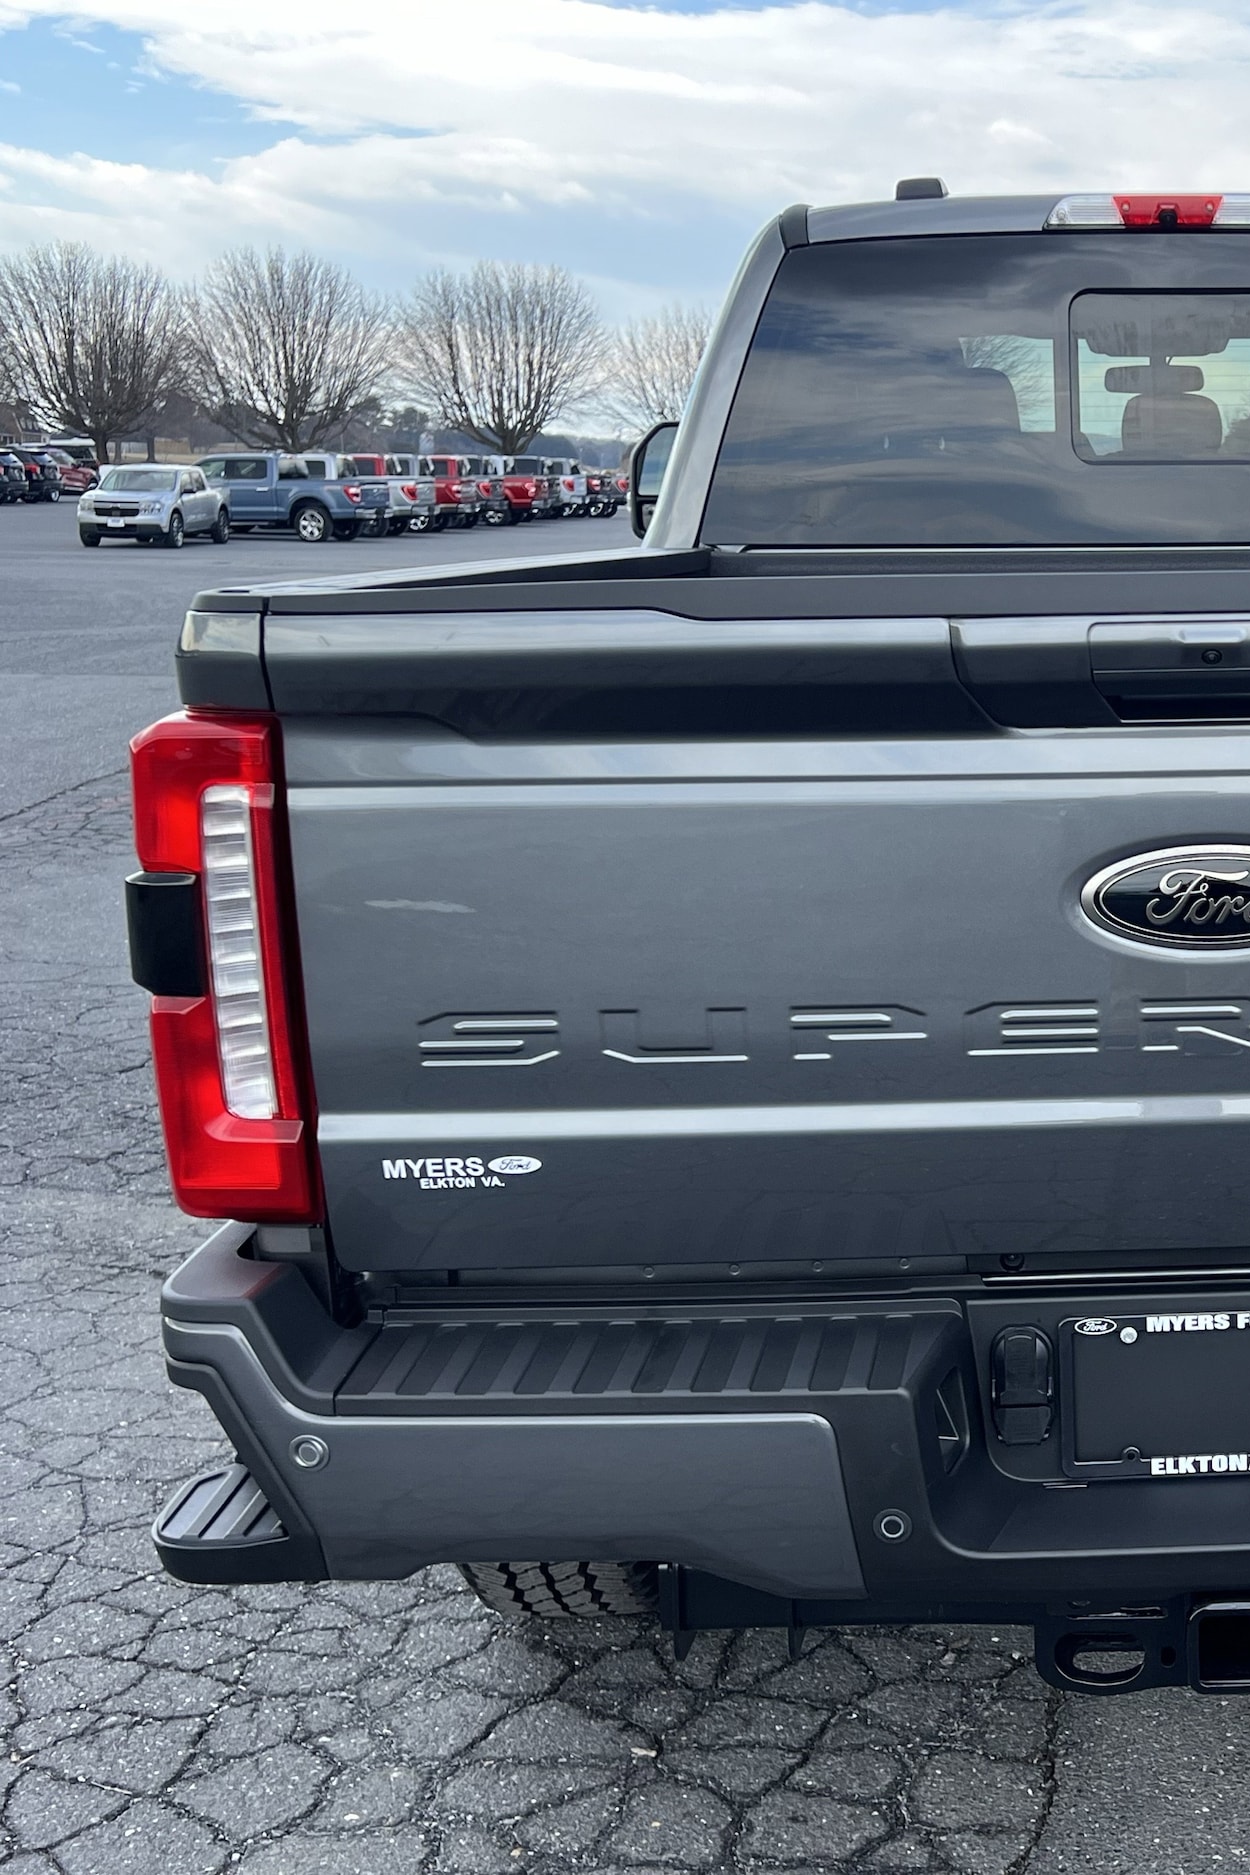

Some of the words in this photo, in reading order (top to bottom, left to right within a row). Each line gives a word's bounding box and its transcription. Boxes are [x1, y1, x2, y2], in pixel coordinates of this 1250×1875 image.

[382, 1156, 485, 1179] MYERS
[498, 1157, 533, 1172] Ford
[420, 1177, 476, 1190] ELKTON
[481, 1175, 506, 1188] VA.
[1080, 1319, 1109, 1333] Ford
[1146, 1313, 1231, 1333] MYERS
